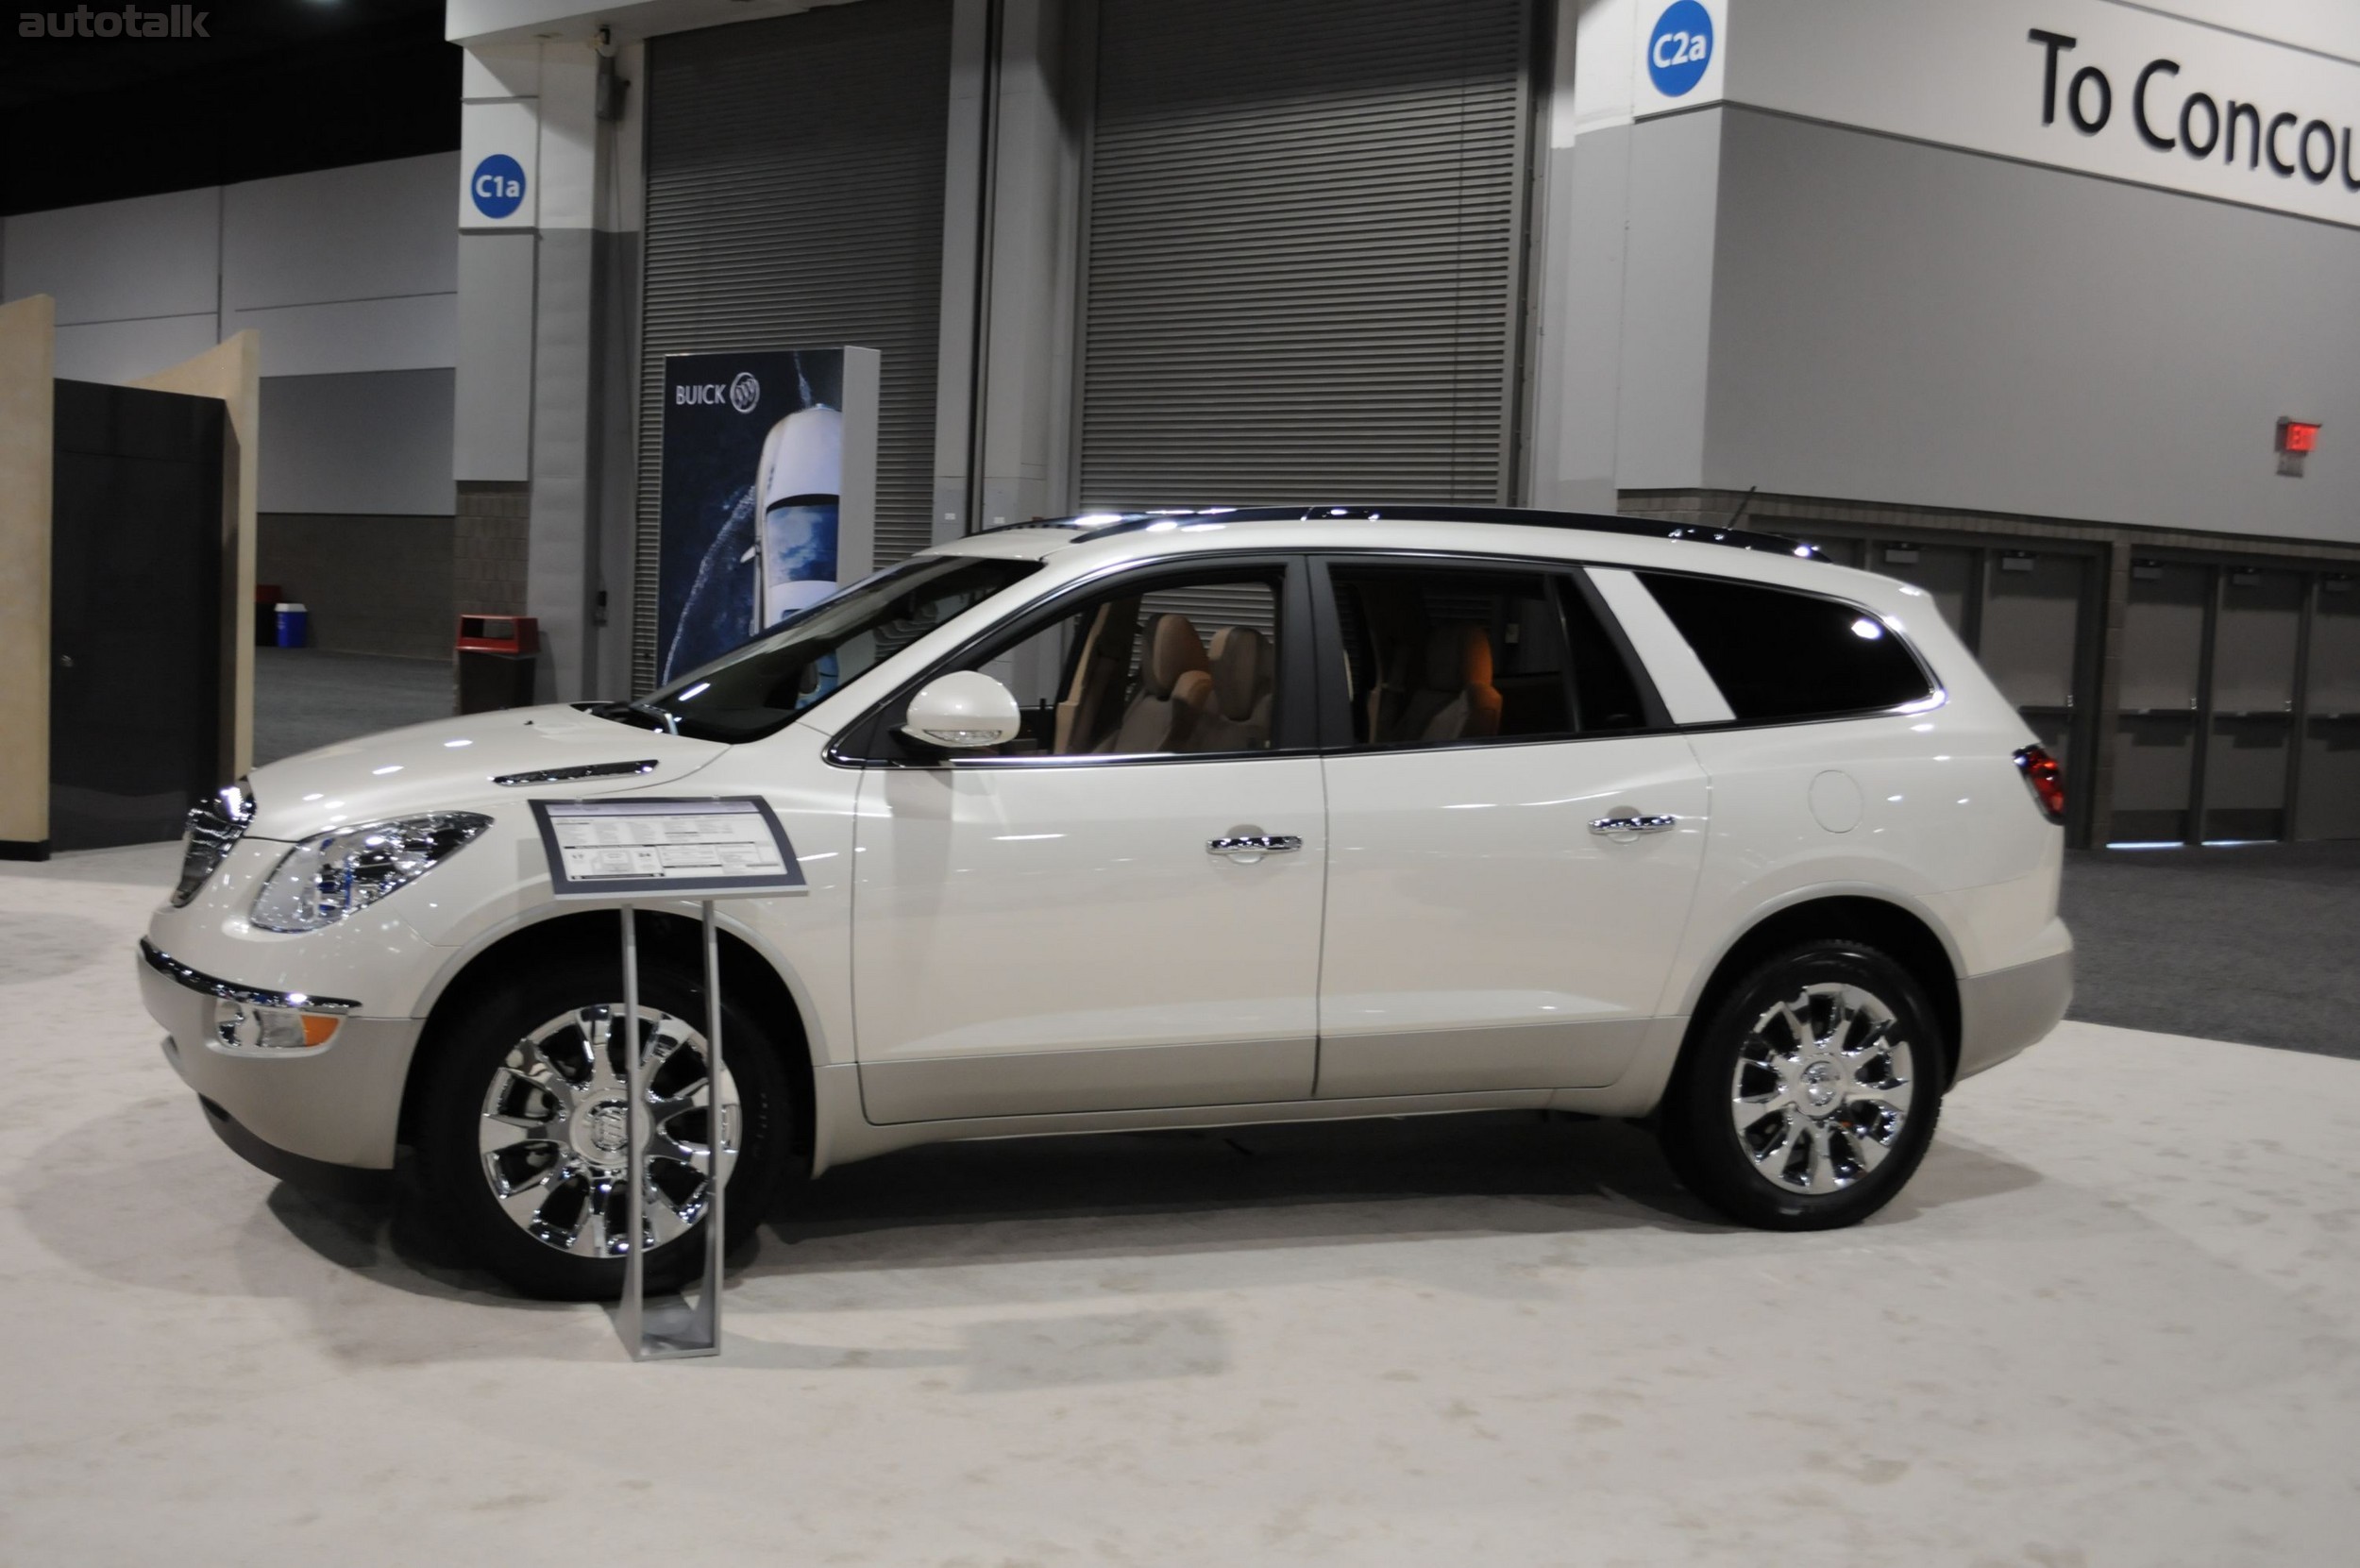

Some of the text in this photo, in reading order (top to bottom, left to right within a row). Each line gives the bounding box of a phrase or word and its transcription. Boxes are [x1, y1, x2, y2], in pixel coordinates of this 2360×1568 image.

[1653, 31, 1706, 68] C2a
[2027, 28, 2112, 135] To
[476, 175, 519, 197] C1a
[676, 384, 726, 404] BUICK
